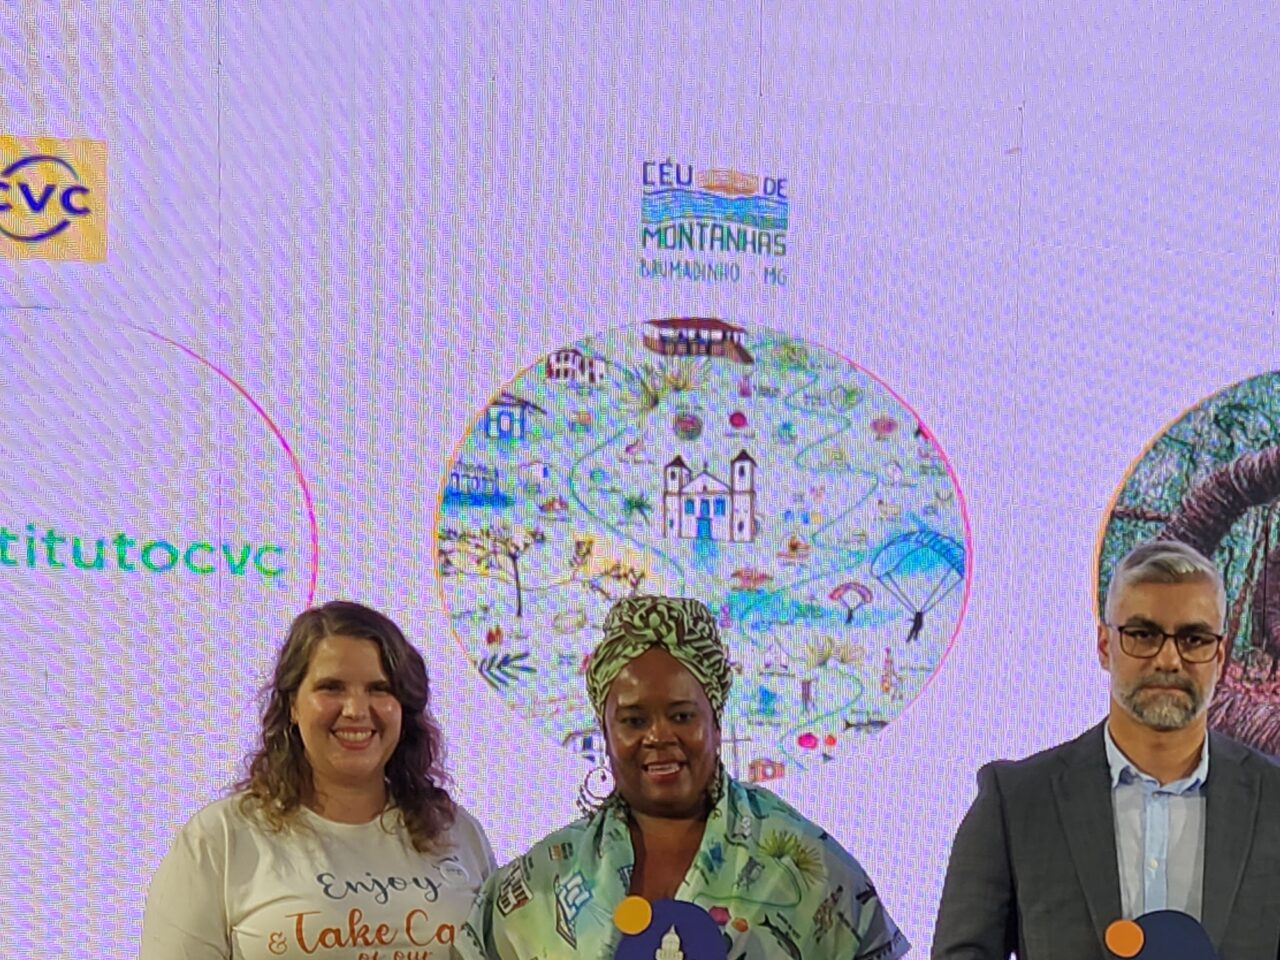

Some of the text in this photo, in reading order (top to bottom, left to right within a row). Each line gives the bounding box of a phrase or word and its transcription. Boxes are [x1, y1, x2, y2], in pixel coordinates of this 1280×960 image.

[643, 156, 788, 198] CÉU DE
[642, 222, 787, 256] MONTANHAS
[316, 872, 443, 904] Enjoy
[285, 908, 398, 954] Take
[405, 909, 464, 947] Ca
